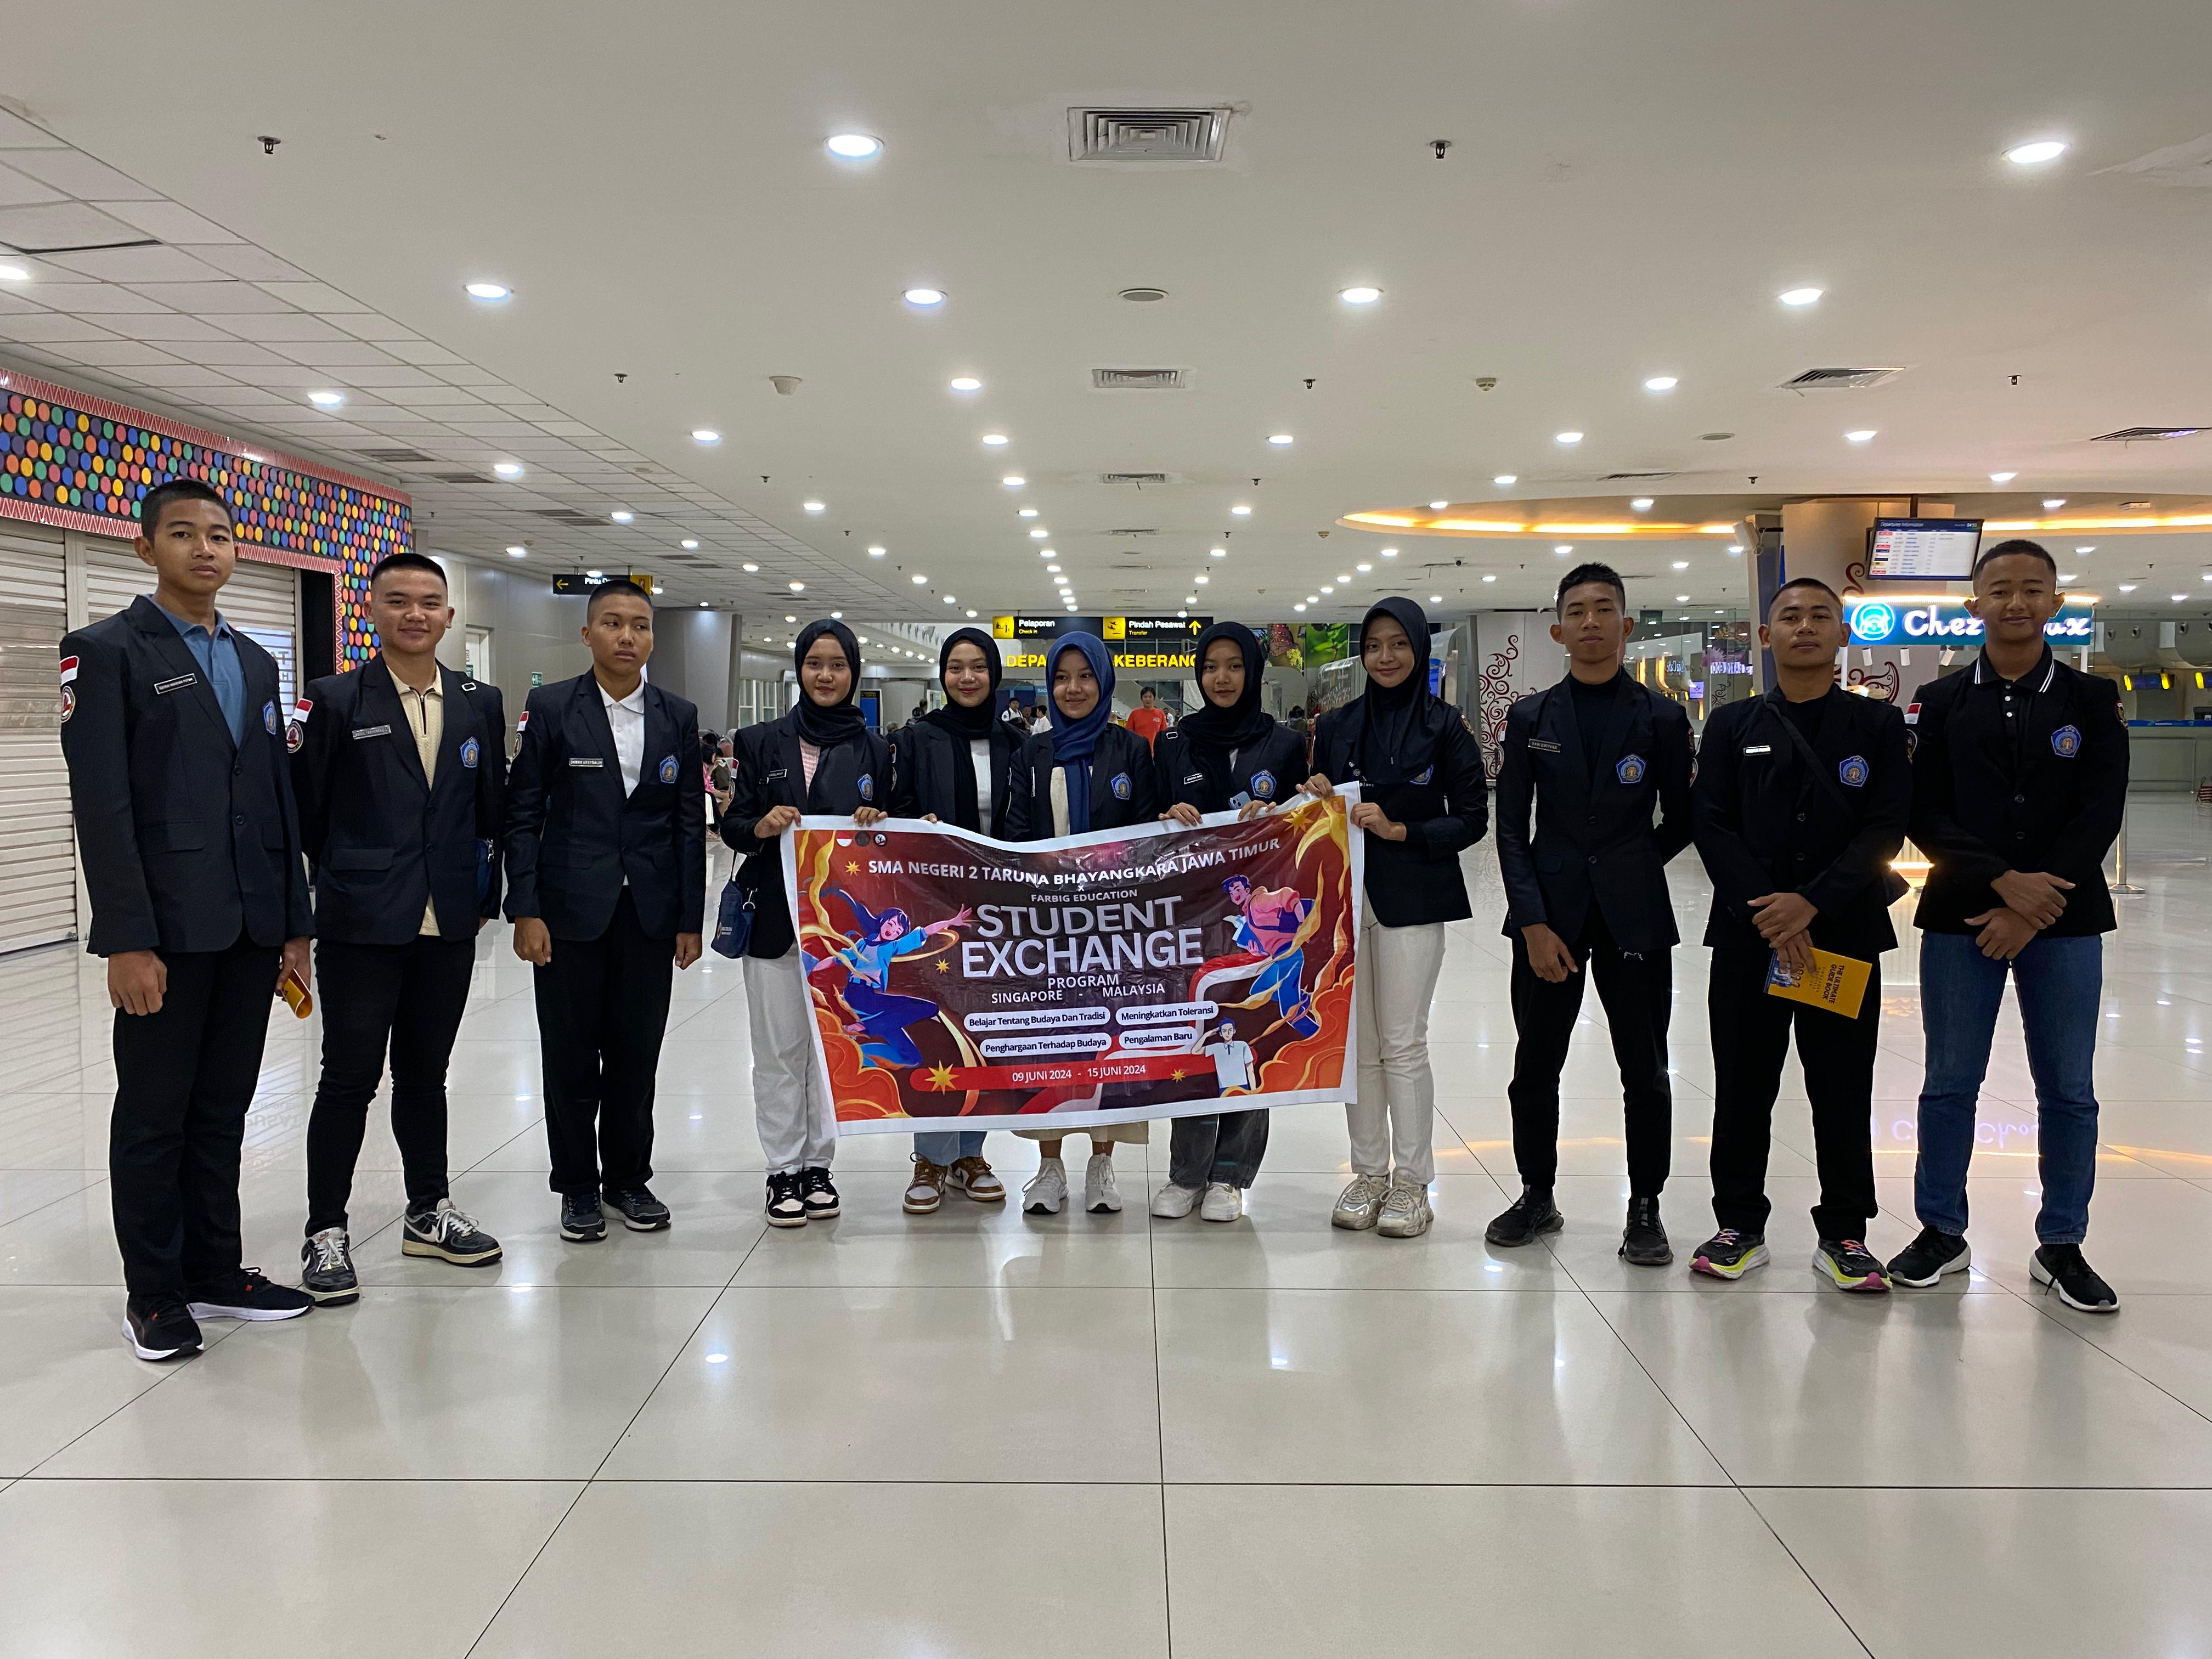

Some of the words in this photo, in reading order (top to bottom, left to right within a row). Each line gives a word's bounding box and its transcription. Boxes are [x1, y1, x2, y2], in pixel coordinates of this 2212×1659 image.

[1018, 619, 1055, 629] Pelaporan
[1128, 620, 1154, 629] Pindah
[1155, 620, 1186, 629] Pesawat
[1904, 604, 1983, 636] Chez
[868, 860, 904, 874] SMA
[909, 861, 964, 878] NEGERI
[968, 866, 978, 879] 2
[981, 867, 1049, 885] TARUNA
[1053, 860, 1178, 885] BHAYANGKARA
[1181, 850, 1226, 874] JAWA
[1229, 838, 1280, 860] TIMUR
[1031, 894, 1070, 903] FARBIG
[1073, 889, 1138, 902] EDUCATION
[977, 895, 1182, 938] STUDENT
[961, 928, 1204, 978] EXCHANGE
[1048, 973, 1119, 989] PROGRAM
[1827, 964, 1837, 982] GUIDE
[991, 989, 1063, 1004] SINGAPORE
[1102, 983, 1165, 998] MALAYSIA
[1822, 982, 1832, 1001] BOOK
[1829, 976, 1841, 1004] ULTIMATE
[969, 1017, 997, 1028] Belajar
[997, 1015, 1029, 1025] Tentang
[1031, 1013, 1061, 1024] Budaya
[1062, 1013, 1077, 1022] Dan
[1079, 1011, 1105, 1020] Tradisi
[1121, 1009, 1177, 1021] Meningkatkan
[1178, 1005, 1214, 1015] Toleransi
[985, 1043, 1037, 1053] Penghargaan
[1039, 1041, 1076, 1050] Terhadap
[1076, 1038, 1107, 1048] Budaya
[1124, 1034, 1172, 1045] Pengalaman
[1173, 1031, 1192, 1041] Baru
[1012, 1073, 1024, 1082] 09
[1025, 1070, 1047, 1082] JUNI
[1049, 1069, 1072, 1080] 2024
[1087, 1068, 1097, 1077] 15
[1099, 1066, 1121, 1079] JUNI
[1123, 1064, 1146, 1075] 2024
